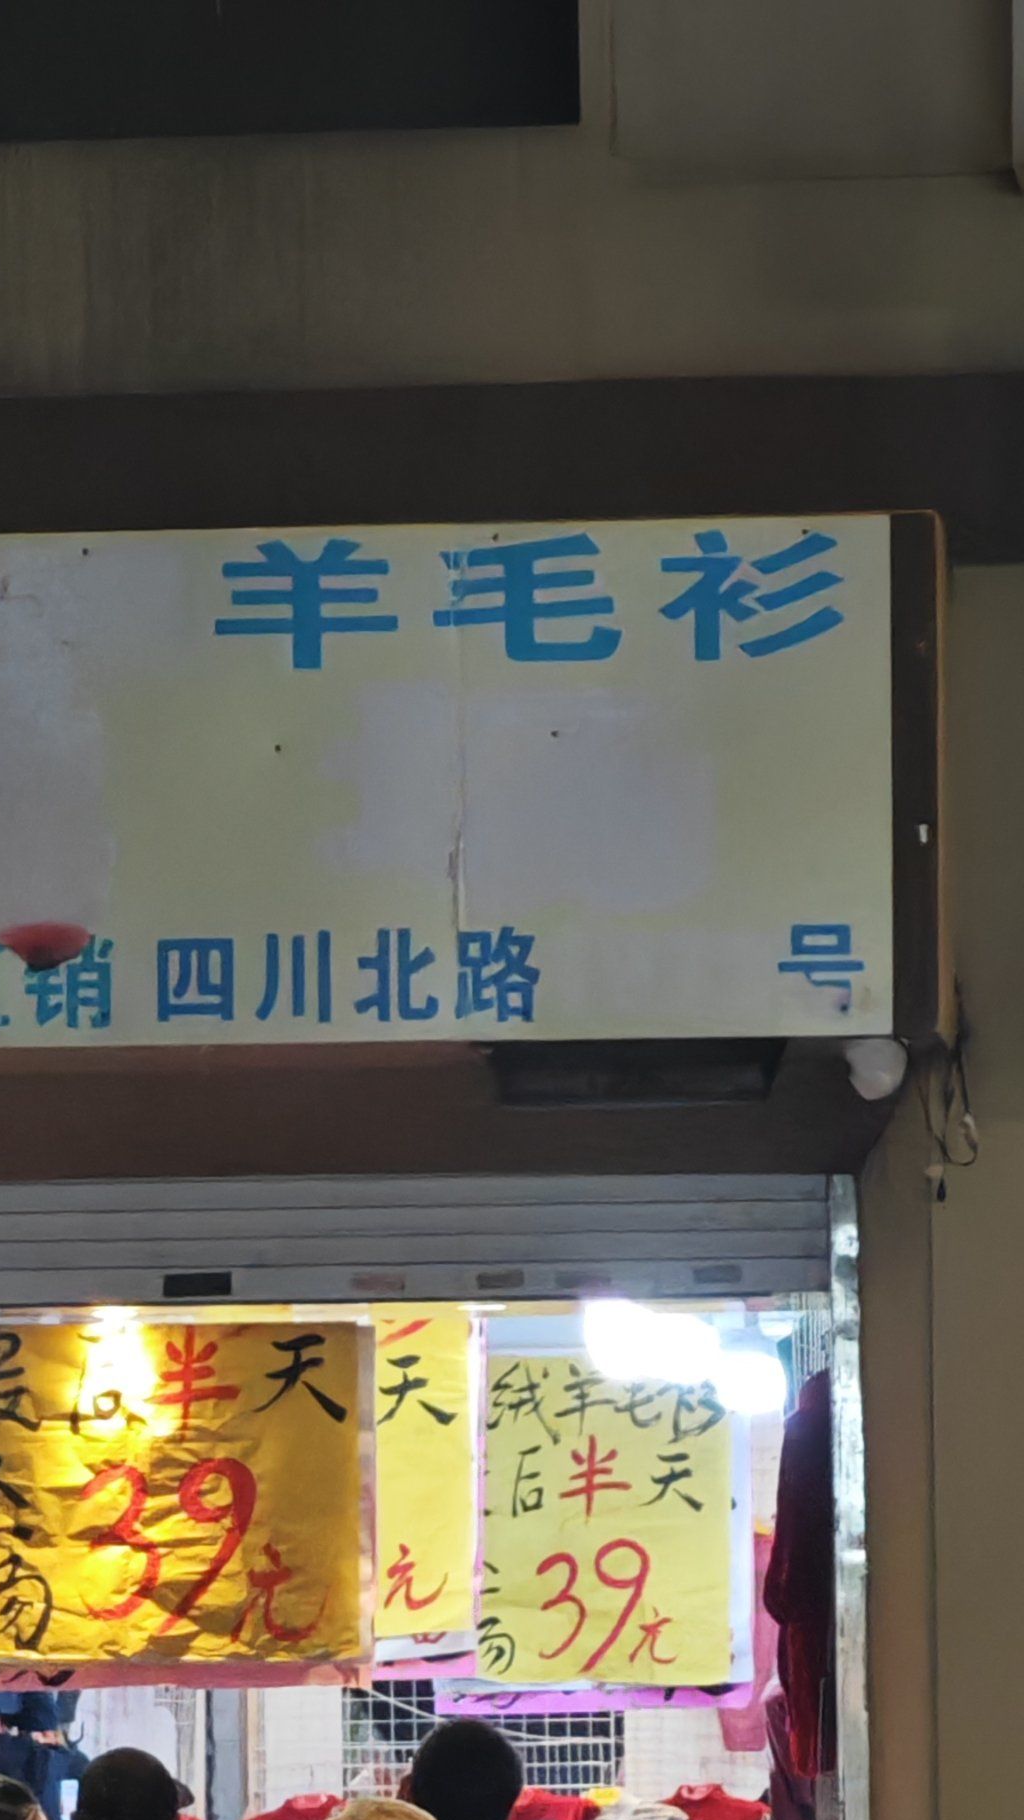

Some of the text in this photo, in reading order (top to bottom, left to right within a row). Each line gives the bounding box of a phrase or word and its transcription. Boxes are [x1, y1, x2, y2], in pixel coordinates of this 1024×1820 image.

[214, 529, 845, 670] 羊毛衫
[378, 1355, 458, 1427] 天
[484, 1434, 704, 1527] 后半天
[383, 1543, 448, 1610] 元
